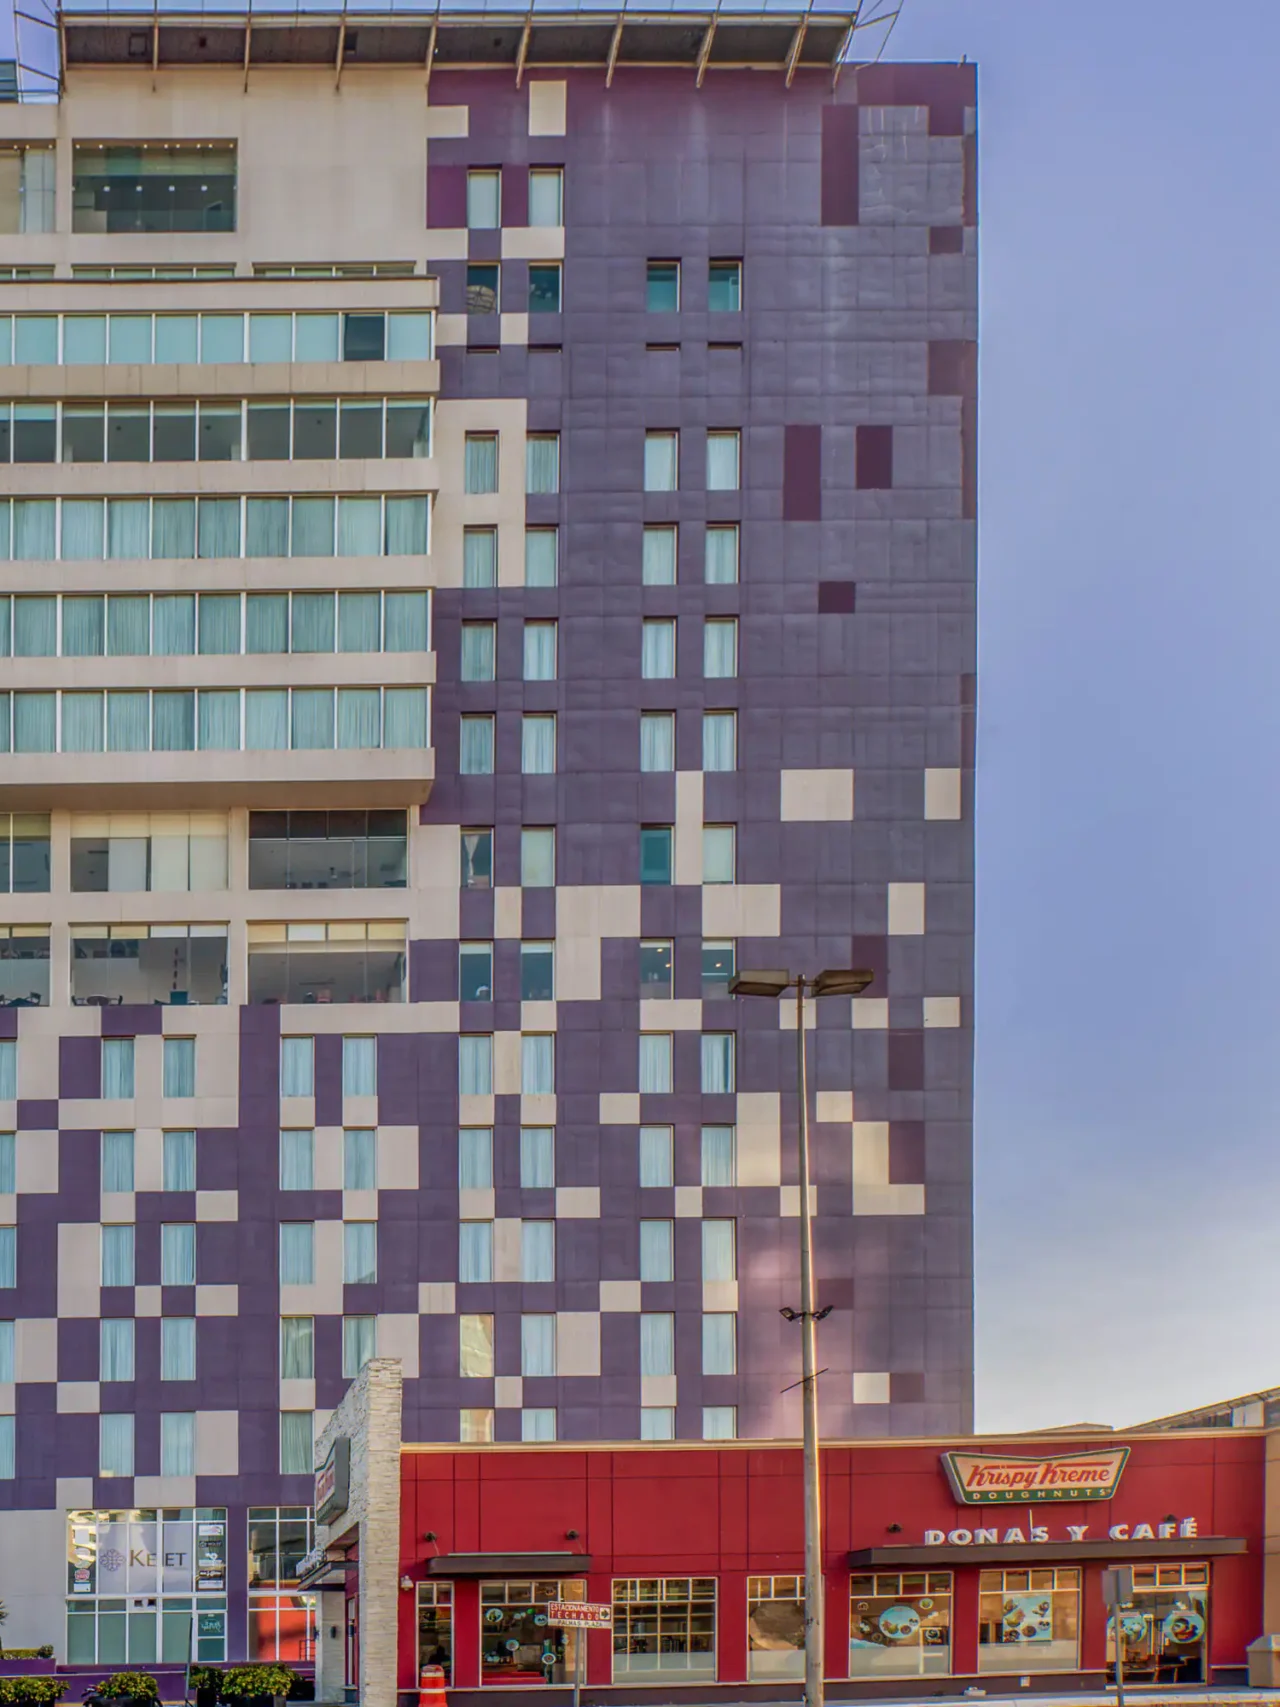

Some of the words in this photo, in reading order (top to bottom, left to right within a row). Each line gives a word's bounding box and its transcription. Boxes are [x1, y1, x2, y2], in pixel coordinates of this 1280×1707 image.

[966, 1464, 1041, 1489] Krispy
[1038, 1461, 1114, 1485] Kreme
[972, 1488, 1109, 1500] DOUGHNUTS
[924, 1526, 1050, 1546] DONAS
[1066, 1525, 1090, 1542] Y
[1108, 1517, 1198, 1541] CAFÉ
[551, 1610, 600, 1621] TECHADO
